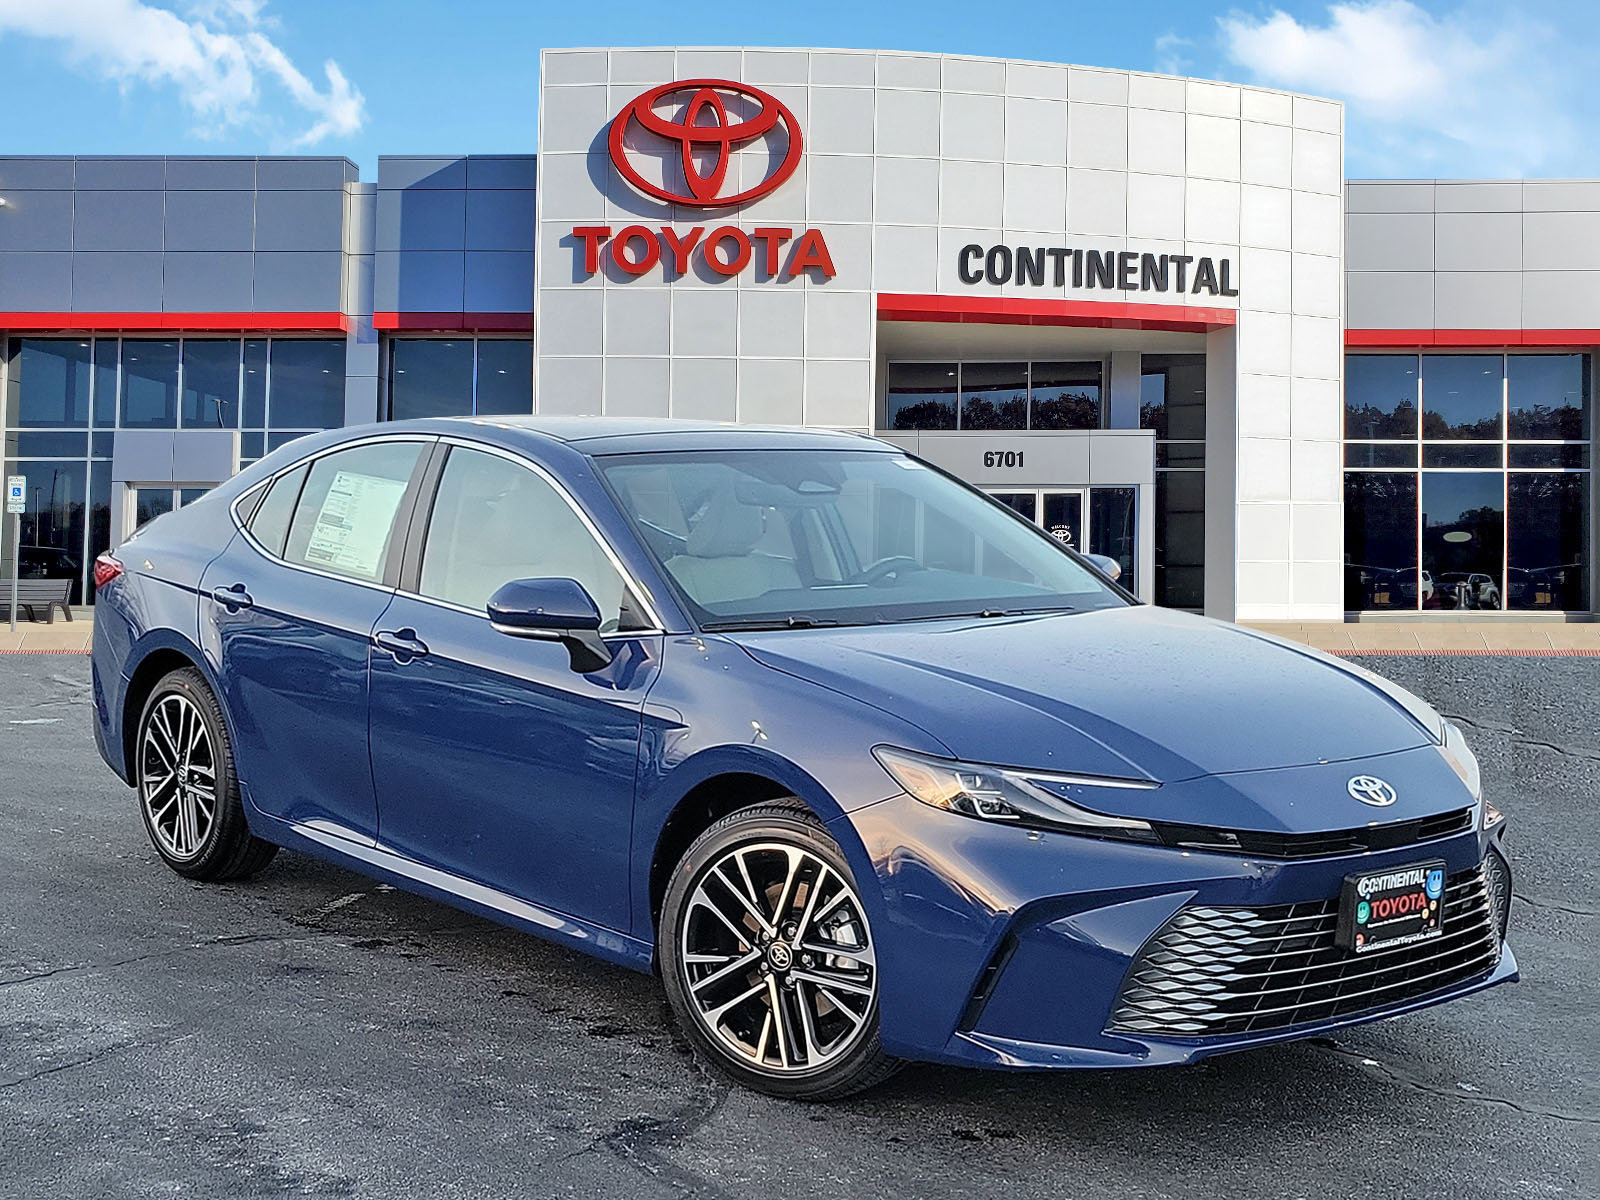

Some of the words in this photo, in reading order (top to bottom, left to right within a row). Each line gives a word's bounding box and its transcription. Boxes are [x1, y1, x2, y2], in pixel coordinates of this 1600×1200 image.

[572, 225, 836, 277] TOYOTA
[958, 244, 1239, 296] CONTINENTAL
[983, 451, 1024, 468] 6701
[1357, 868, 1426, 897] CONTINENTAL
[1371, 892, 1427, 919] TOYOTA
[1355, 929, 1443, 953] ContinentalToyota.com
